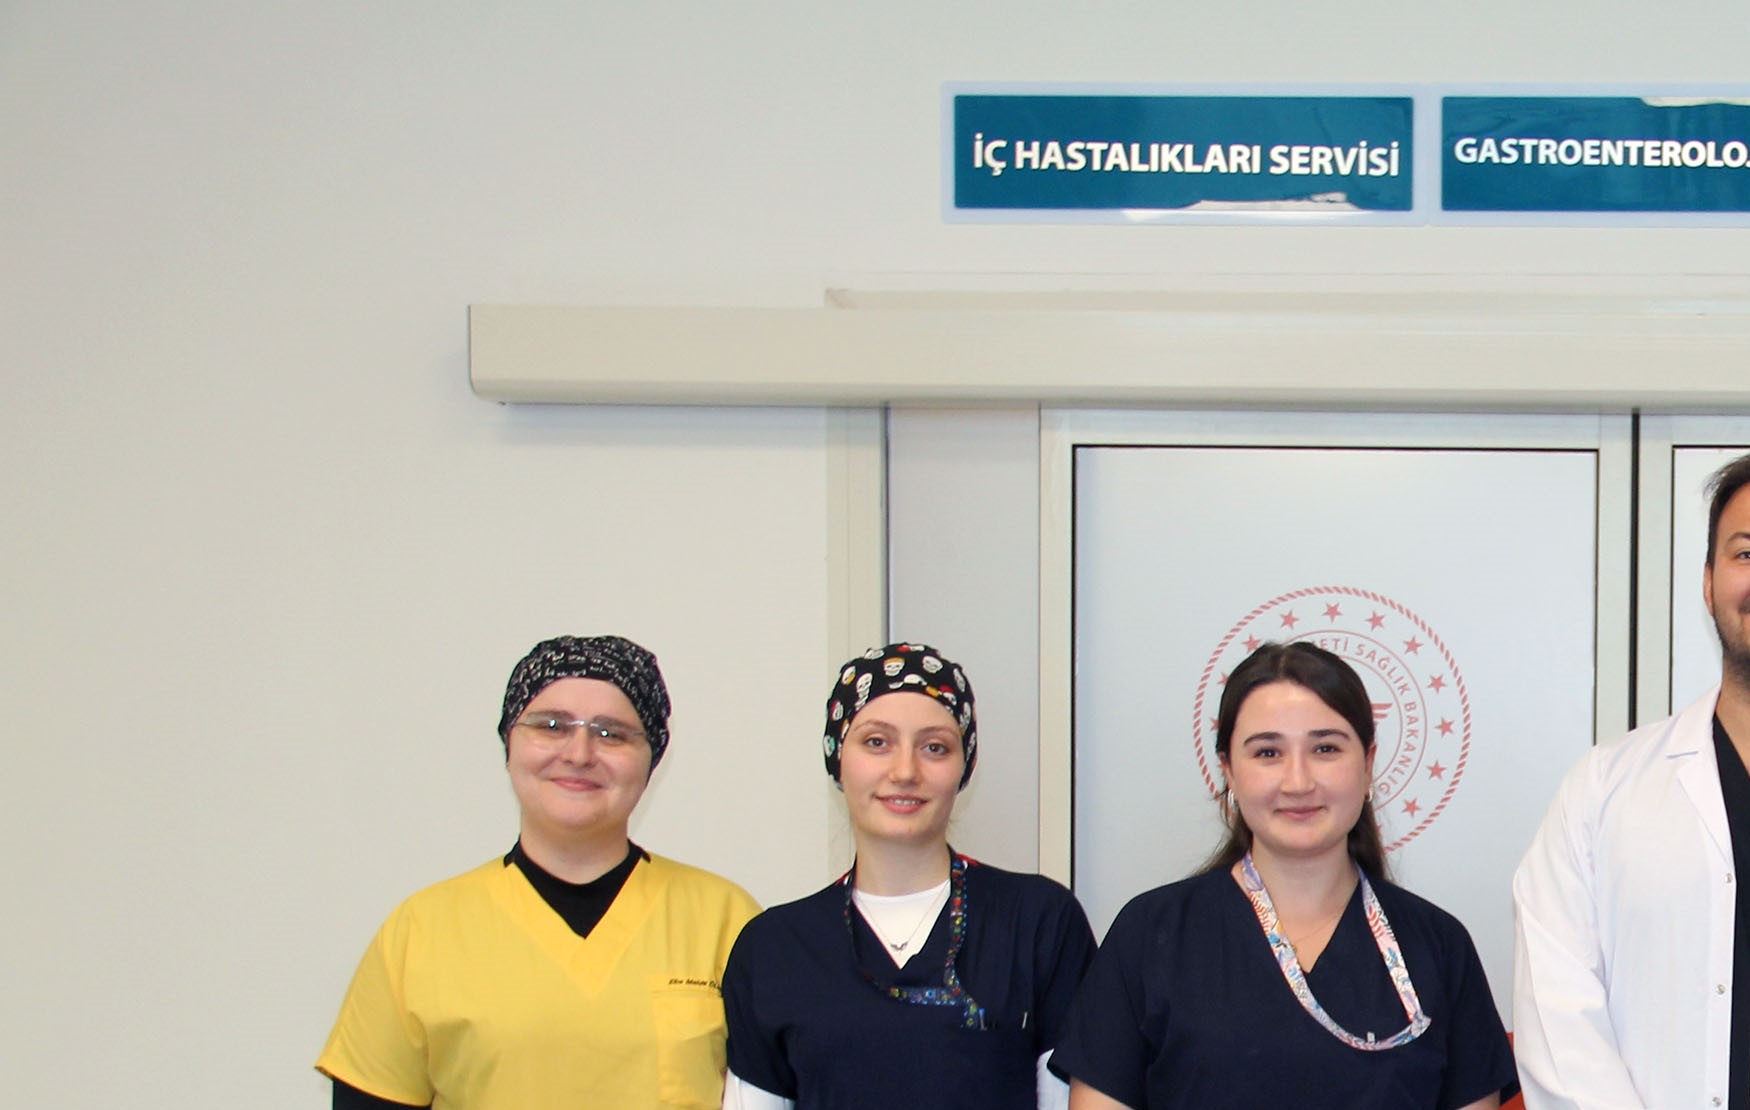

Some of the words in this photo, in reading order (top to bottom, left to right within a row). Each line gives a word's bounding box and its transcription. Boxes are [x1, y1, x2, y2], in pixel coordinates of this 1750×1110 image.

[973, 132, 1008, 176] İÇ
[1014, 140, 1262, 174] HASTALIKLARI
[1268, 140, 1400, 177] SERVİSİ
